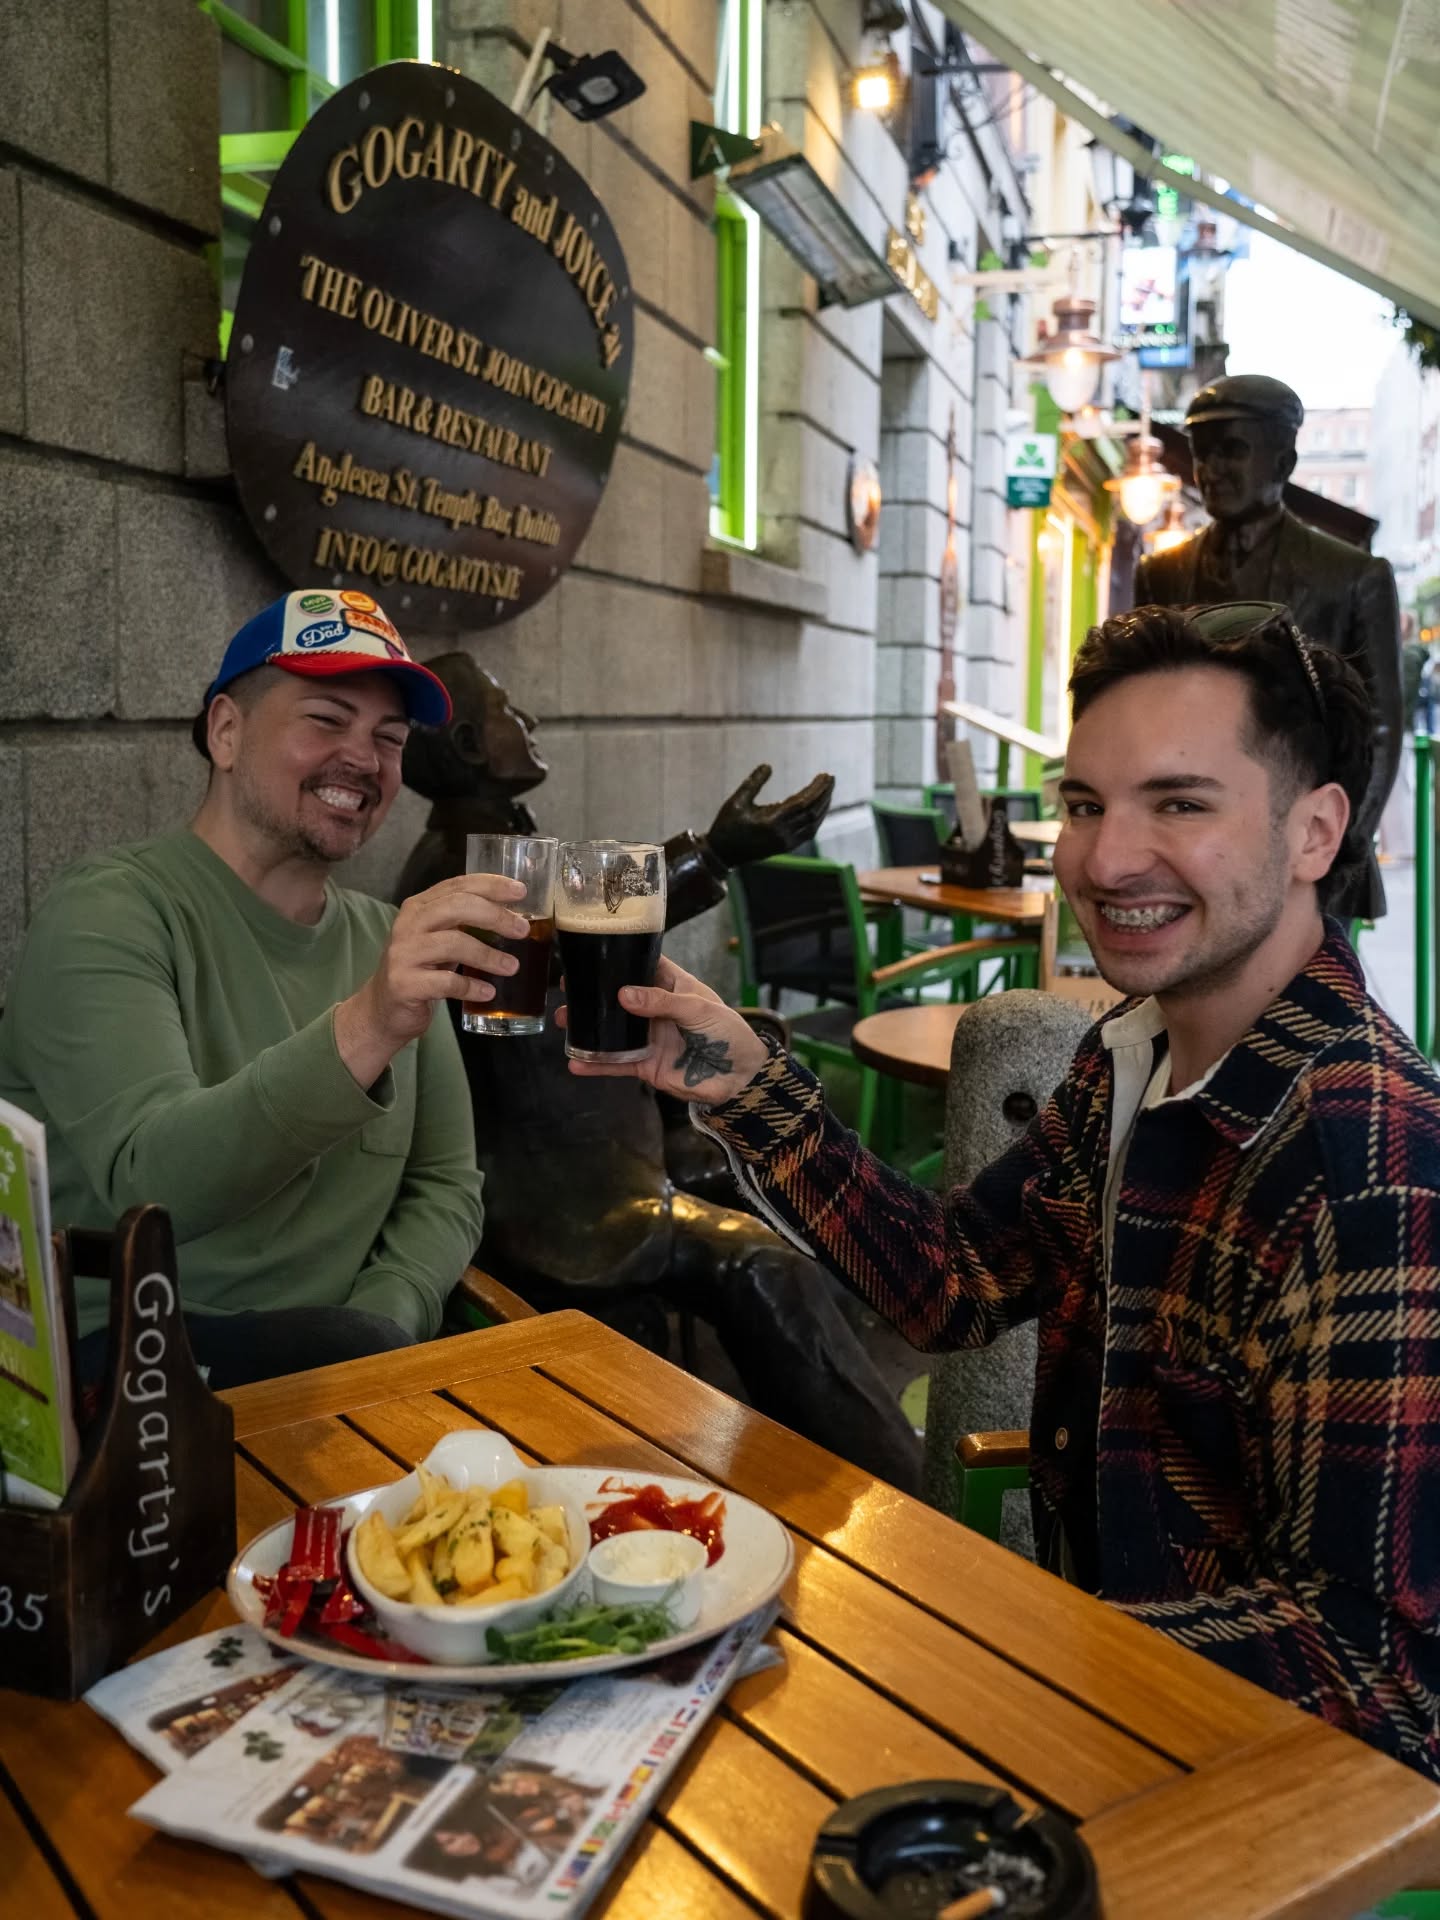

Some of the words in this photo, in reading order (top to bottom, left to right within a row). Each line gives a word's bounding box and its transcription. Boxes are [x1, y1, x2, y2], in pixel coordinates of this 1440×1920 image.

[327, 116, 518, 214] GOGARTY
[511, 186, 559, 244] and
[300, 255, 363, 320] THE
[362, 286, 453, 365] OLIVER
[450, 328, 484, 377] ST.
[482, 346, 533, 399] JOHN
[530, 369, 609, 433] GOGARTY
[361, 375, 416, 425] BAR
[413, 394, 434, 435] &
[433, 402, 554, 478] RESTAURANT
[293, 441, 390, 508] Anglesea
[422, 476, 482, 532] Temple
[513, 503, 562, 547] Dublin
[302, 621, 346, 648] Dad
[122, 1271, 180, 1618] Gogarty's
